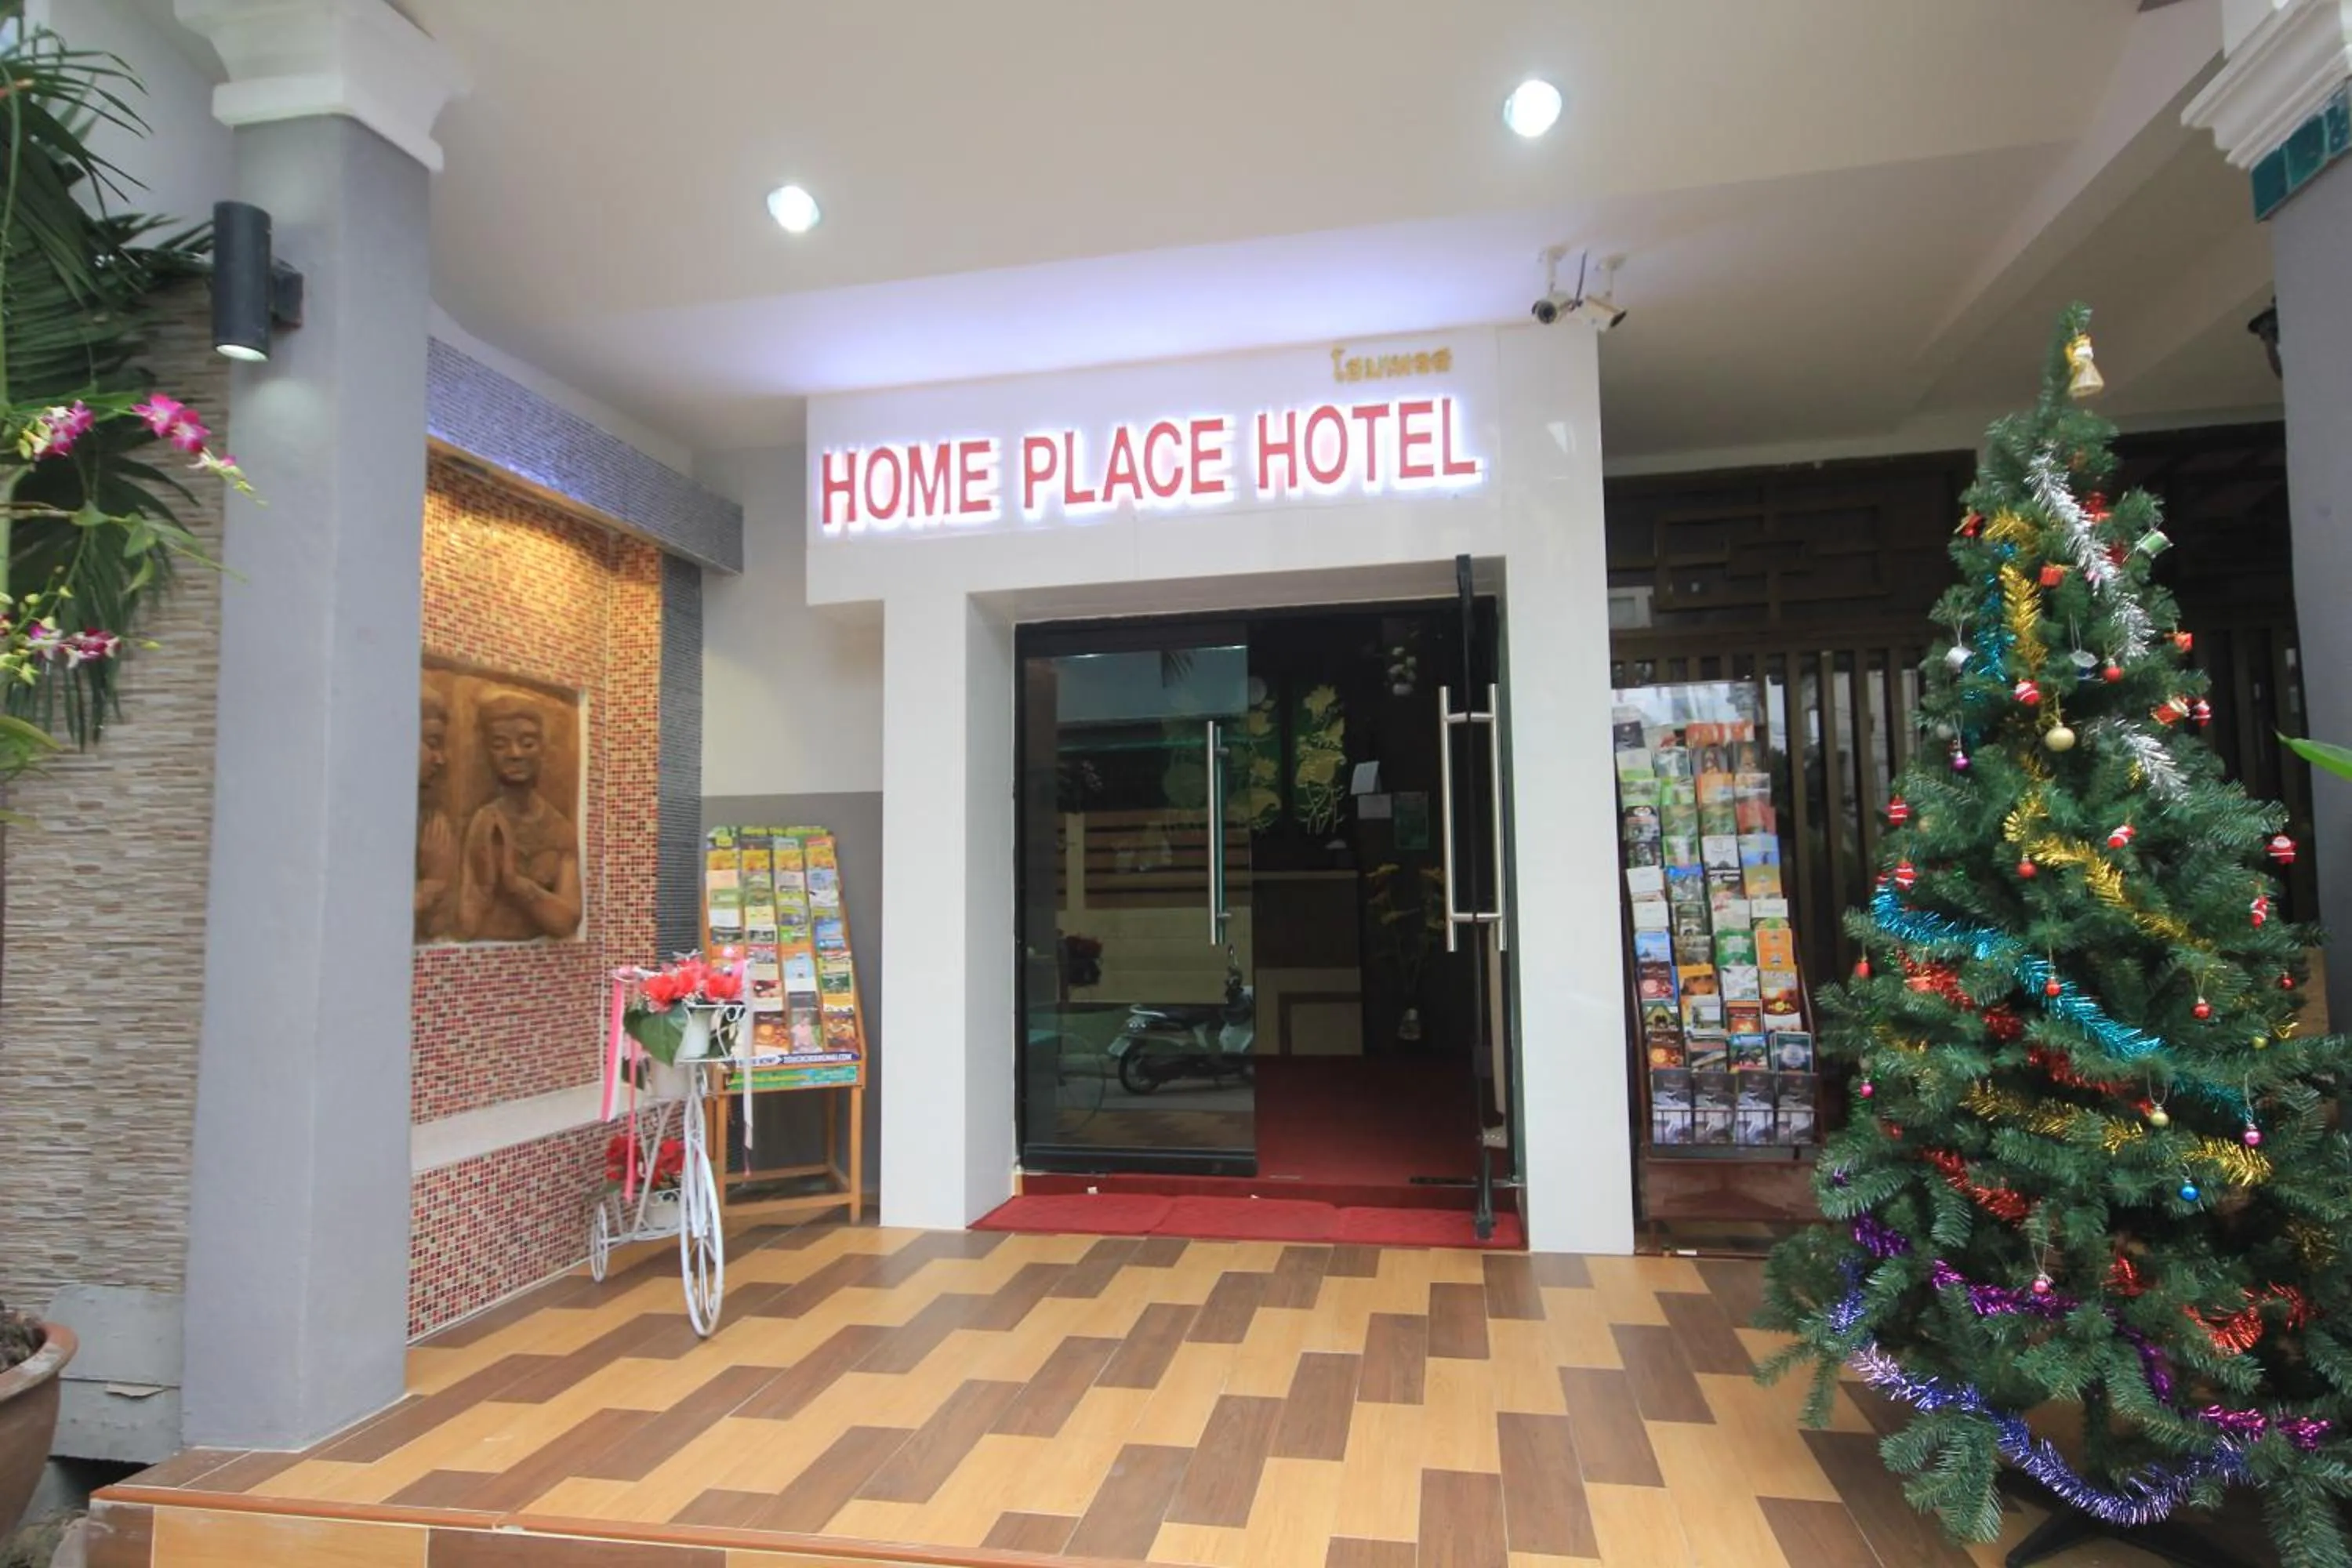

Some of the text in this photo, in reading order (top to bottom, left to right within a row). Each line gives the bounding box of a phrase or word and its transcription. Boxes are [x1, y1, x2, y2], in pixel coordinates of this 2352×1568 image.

[822, 397, 1476, 524] HOME PLACE HOTEL
